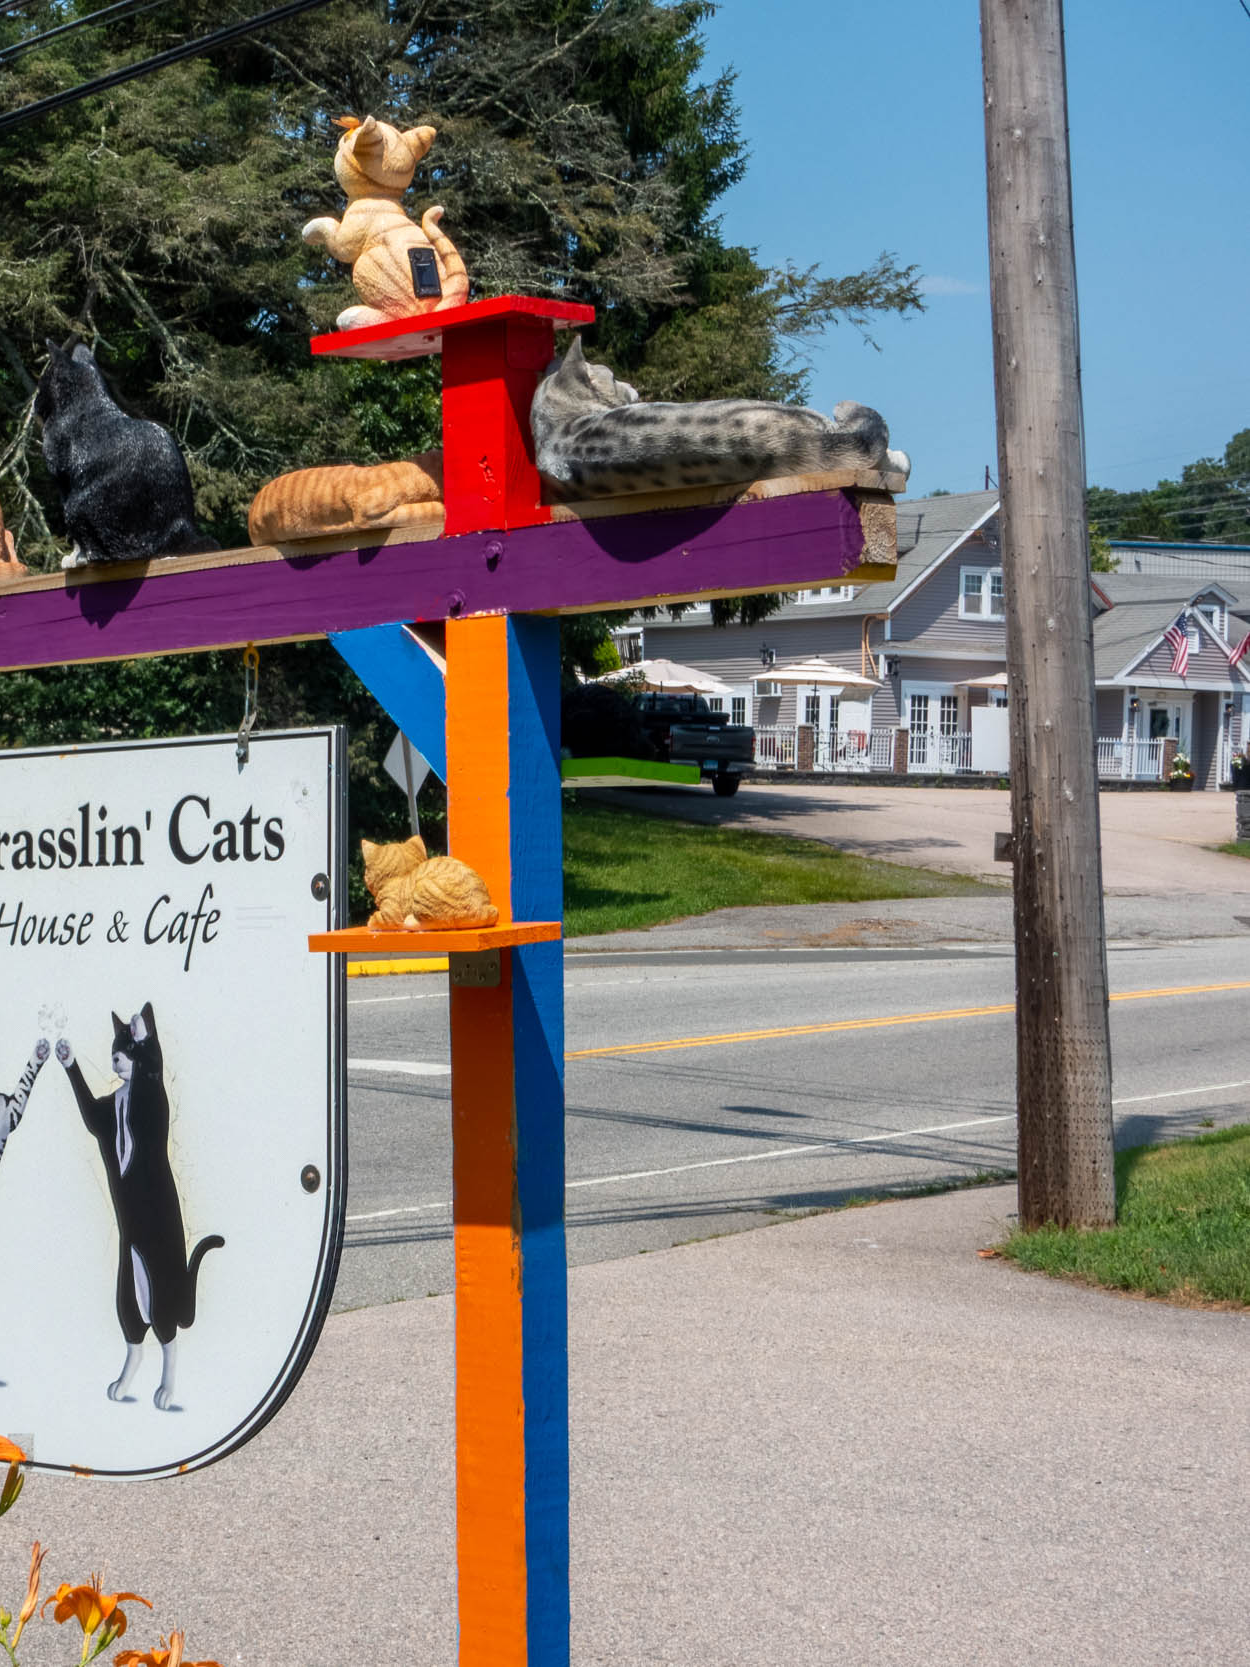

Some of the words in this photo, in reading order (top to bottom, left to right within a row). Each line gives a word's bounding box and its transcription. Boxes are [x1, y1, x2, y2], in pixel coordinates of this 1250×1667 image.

[168, 794, 285, 865] Cats
[106, 911, 129, 944] &
[144, 883, 221, 972] Cafe
